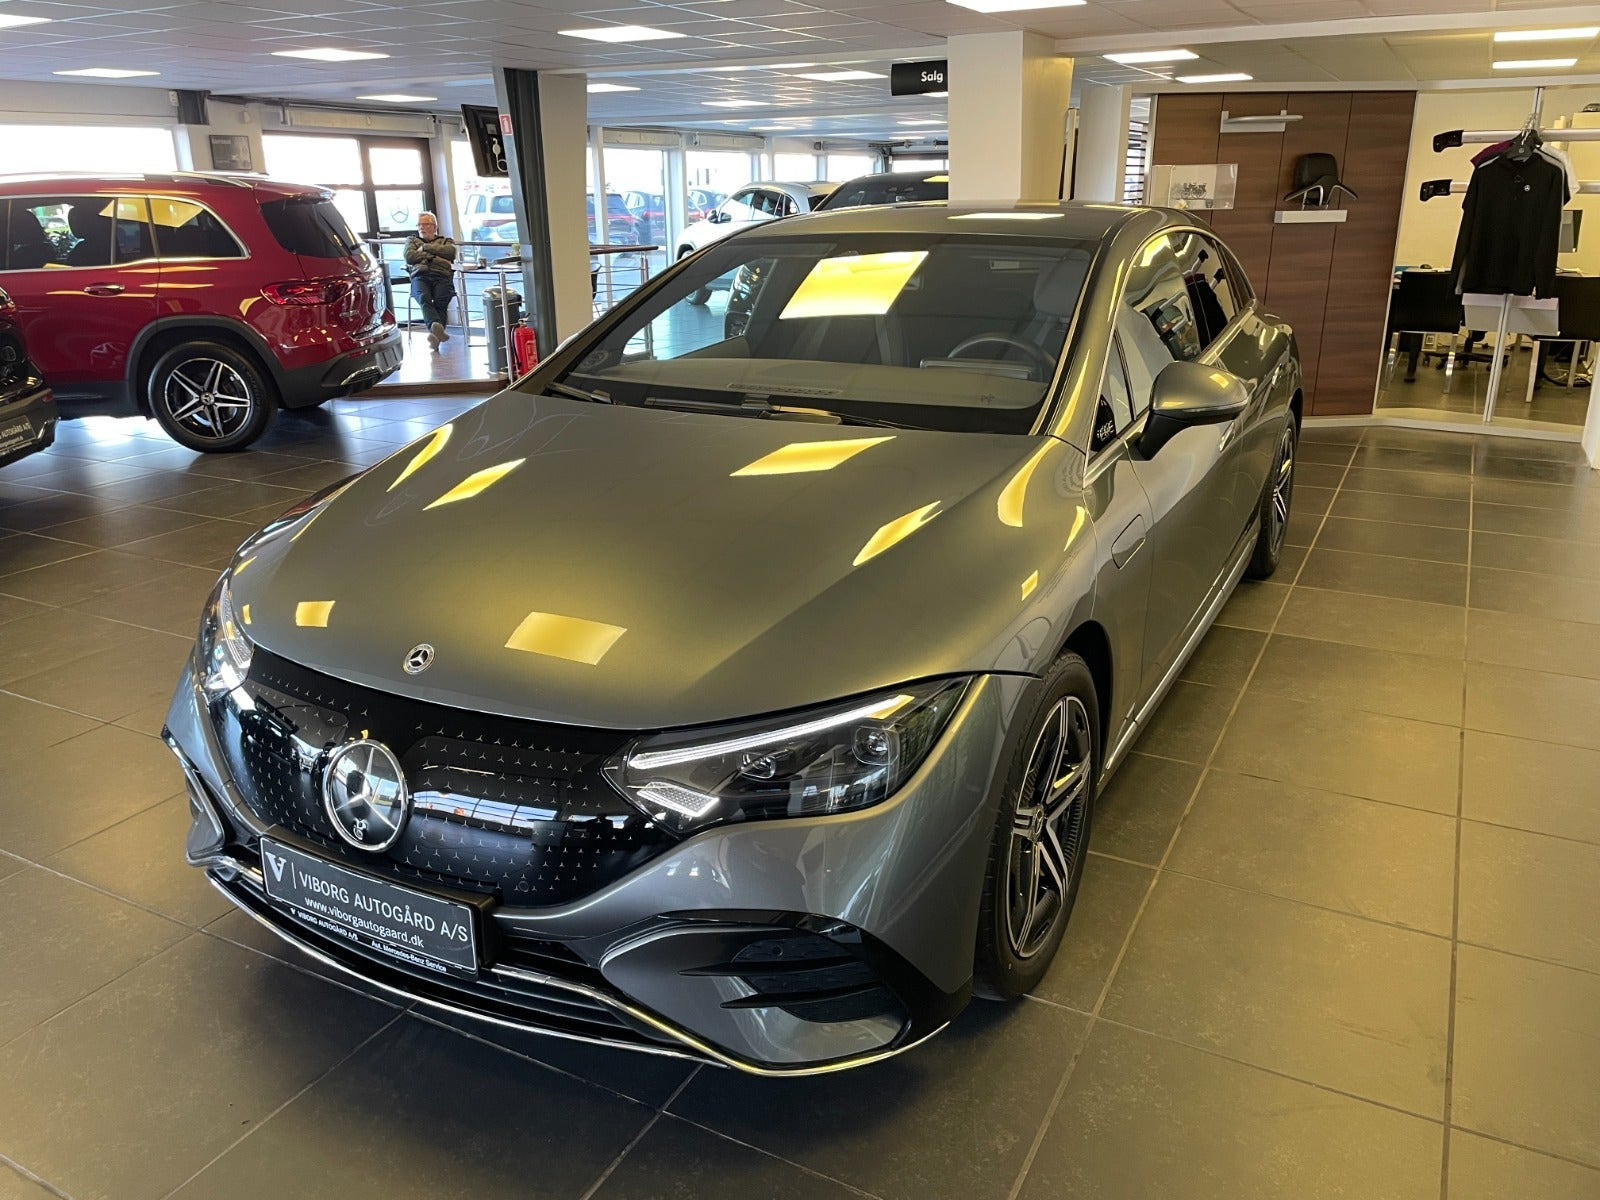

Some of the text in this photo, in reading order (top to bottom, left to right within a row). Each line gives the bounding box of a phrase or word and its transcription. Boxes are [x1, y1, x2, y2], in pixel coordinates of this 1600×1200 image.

[921, 70, 944, 83] Salg
[299, 871, 468, 943] VIBORG AUTOGÅRD A/S
[297, 910, 318, 925] VIBORG
[318, 919, 347, 936] AUTOGÅRD
[304, 896, 425, 948] www.viborgautogaard.dk
[382, 944, 425, 965] Mercedes-Benz
[425, 958, 447, 973] Service
